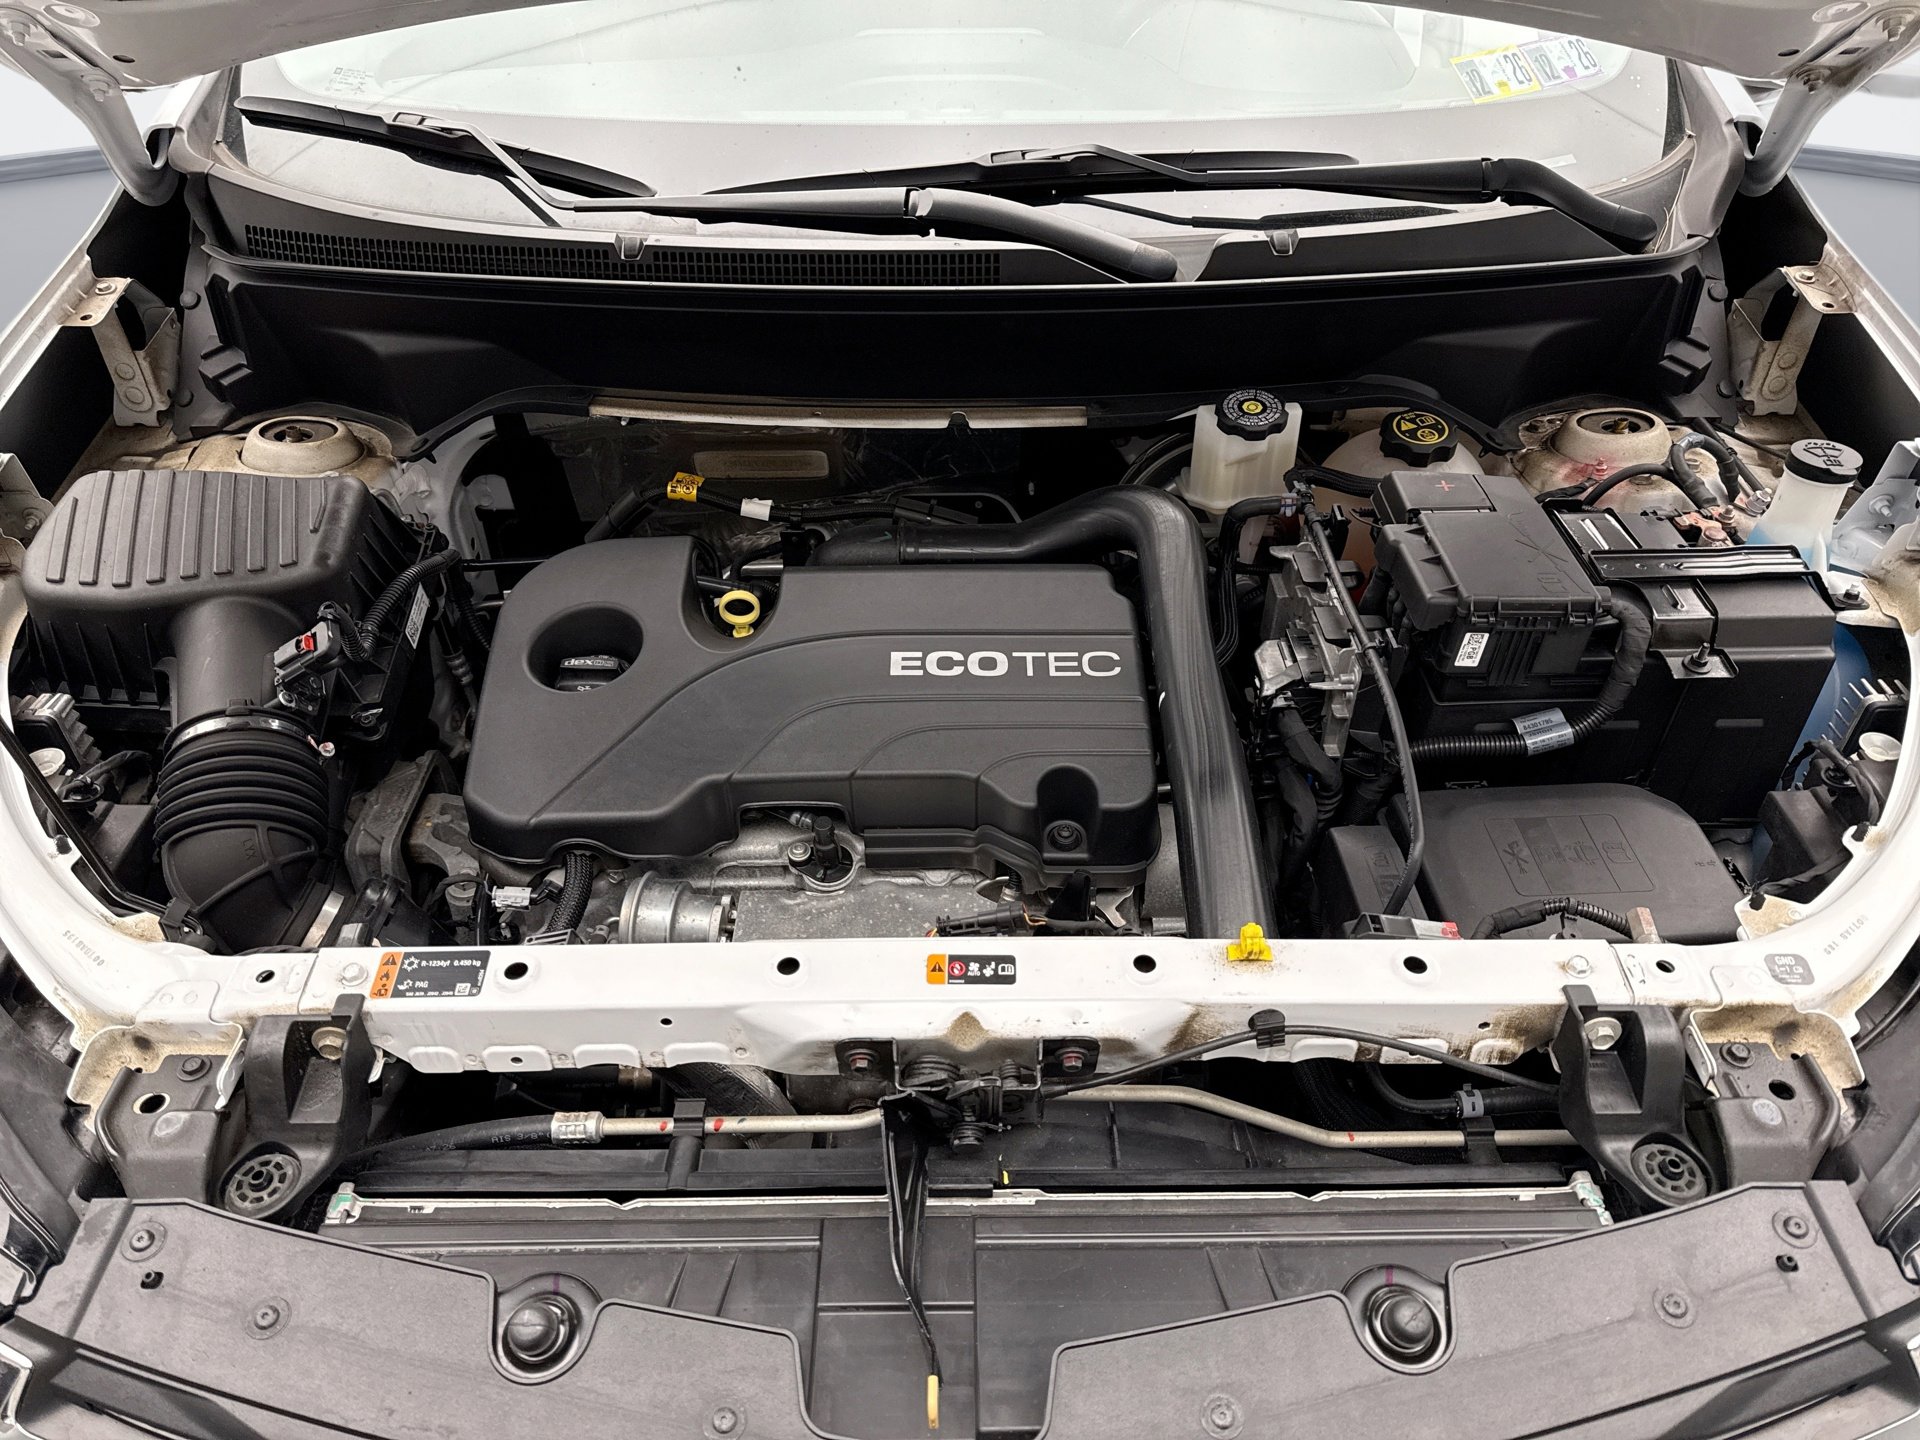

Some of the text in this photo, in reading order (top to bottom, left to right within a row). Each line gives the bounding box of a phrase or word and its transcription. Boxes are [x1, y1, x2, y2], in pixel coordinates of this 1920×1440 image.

[1534, 53, 1562, 82] 12
[1567, 38, 1598, 71] 26
[1465, 68, 1493, 97] 12
[1503, 52, 1534, 86] 26
[889, 651, 1122, 677] ECOTEC
[420, 959, 482, 968] R-1234yf 0.450 kg
[1774, 956, 1796, 966] GND
[414, 980, 429, 988] PAG
